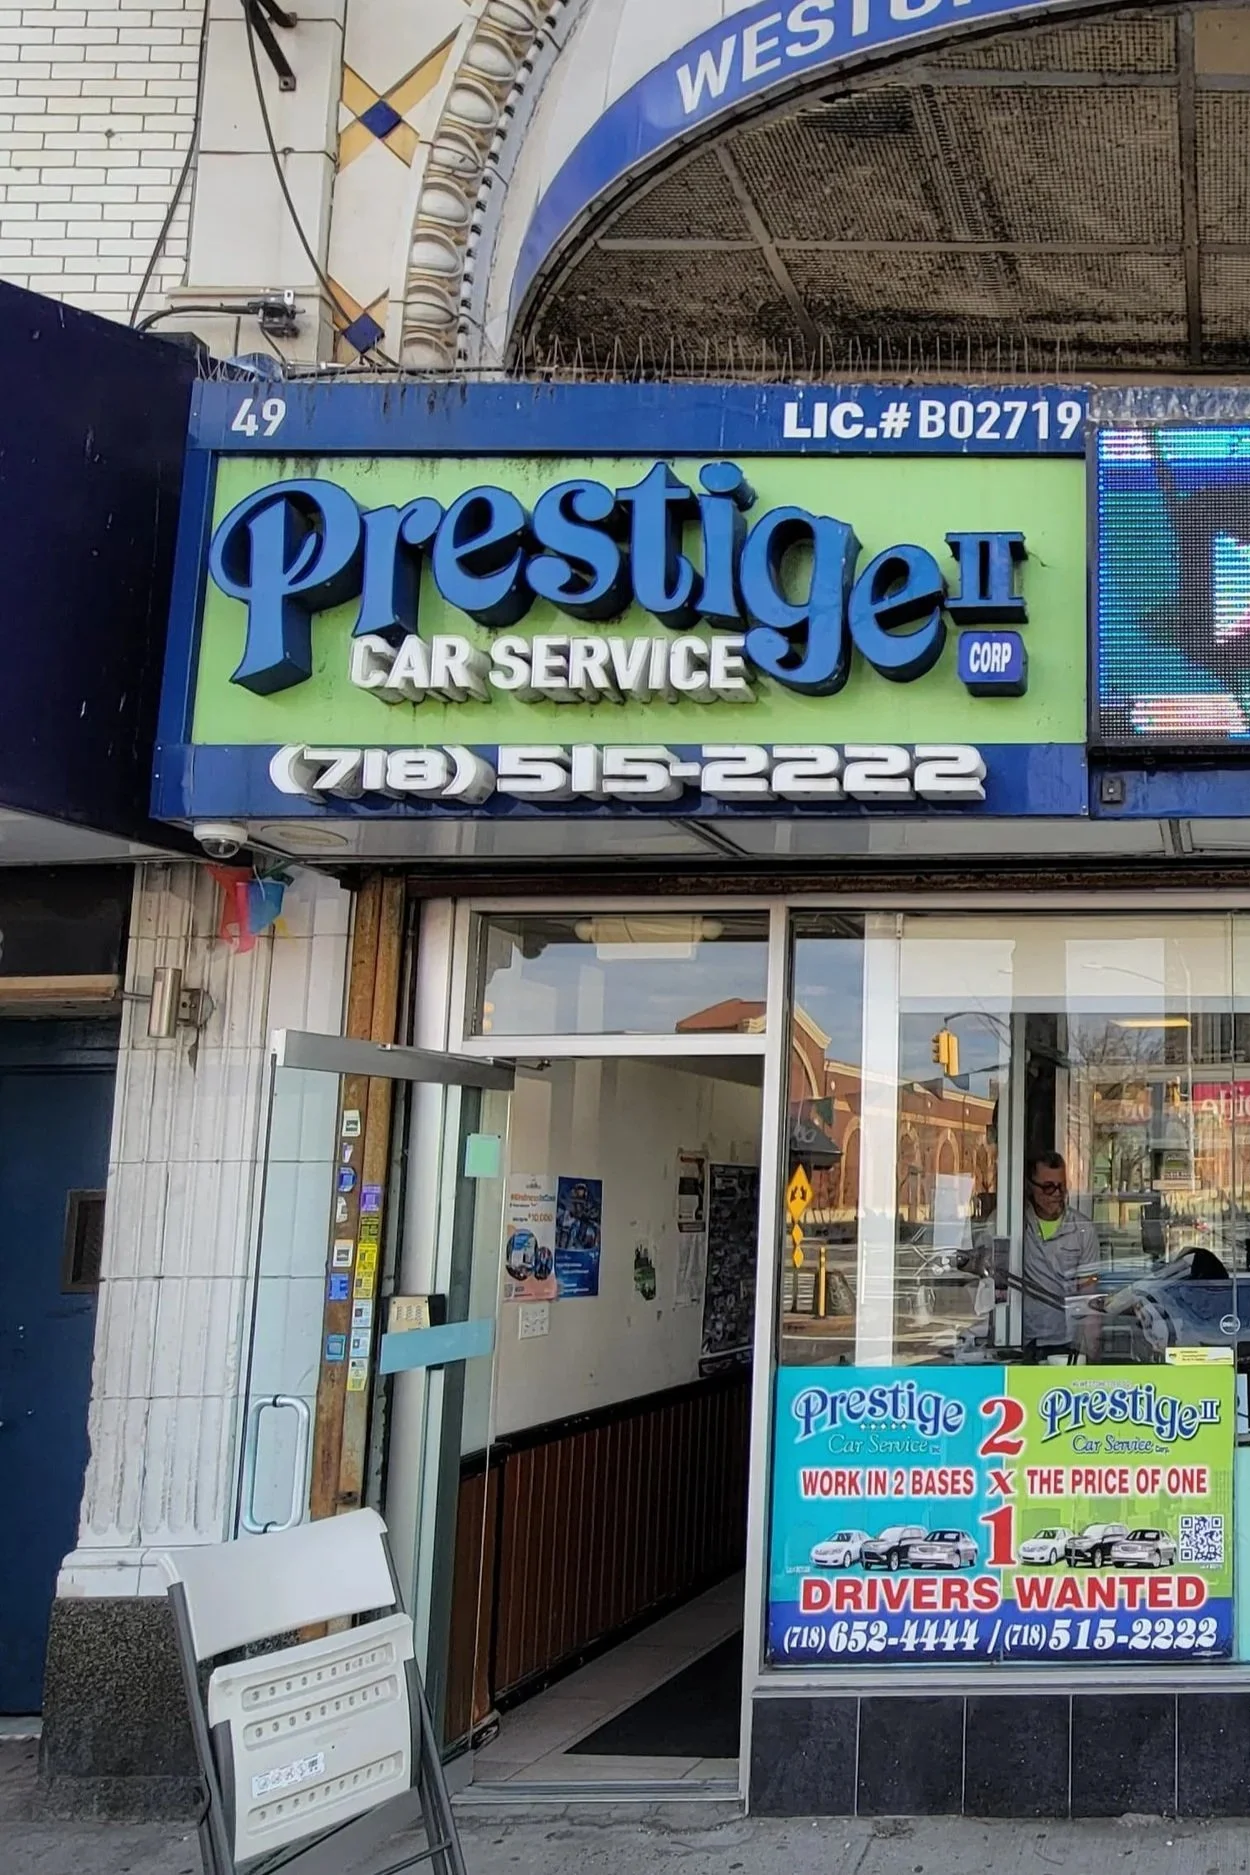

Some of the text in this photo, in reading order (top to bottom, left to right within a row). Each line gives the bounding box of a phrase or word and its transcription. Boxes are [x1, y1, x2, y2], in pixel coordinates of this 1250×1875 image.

[231, 398, 286, 437] 49
[918, 400, 1082, 440] B02719
[208, 461, 1028, 696] Prestige II
[350, 635, 756, 697] CAR SERVICE
[969, 641, 1012, 673] CORP
[269, 742, 986, 800] (718) 515-2222
[794, 1380, 964, 1438] Prestige
[980, 1398, 1025, 1456] 2
[1040, 1384, 1218, 1441] Prestige II
[828, 1434, 863, 1454] Car
[867, 1434, 928, 1455] Service
[1072, 1435, 1101, 1454] Car
[1104, 1434, 1153, 1455] Service
[802, 1469, 974, 1496] WORK IN 2 BASES
[1027, 1468, 1208, 1495] THE PRICE OF ONE
[981, 1505, 1016, 1565] 1
[802, 1576, 1206, 1611] DRIVERS WANTED
[783, 1625, 827, 1654] (718)
[828, 1618, 980, 1653] 652-4444
[1004, 1622, 1047, 1651] (718)
[1049, 1616, 1218, 1651] 515-2222
